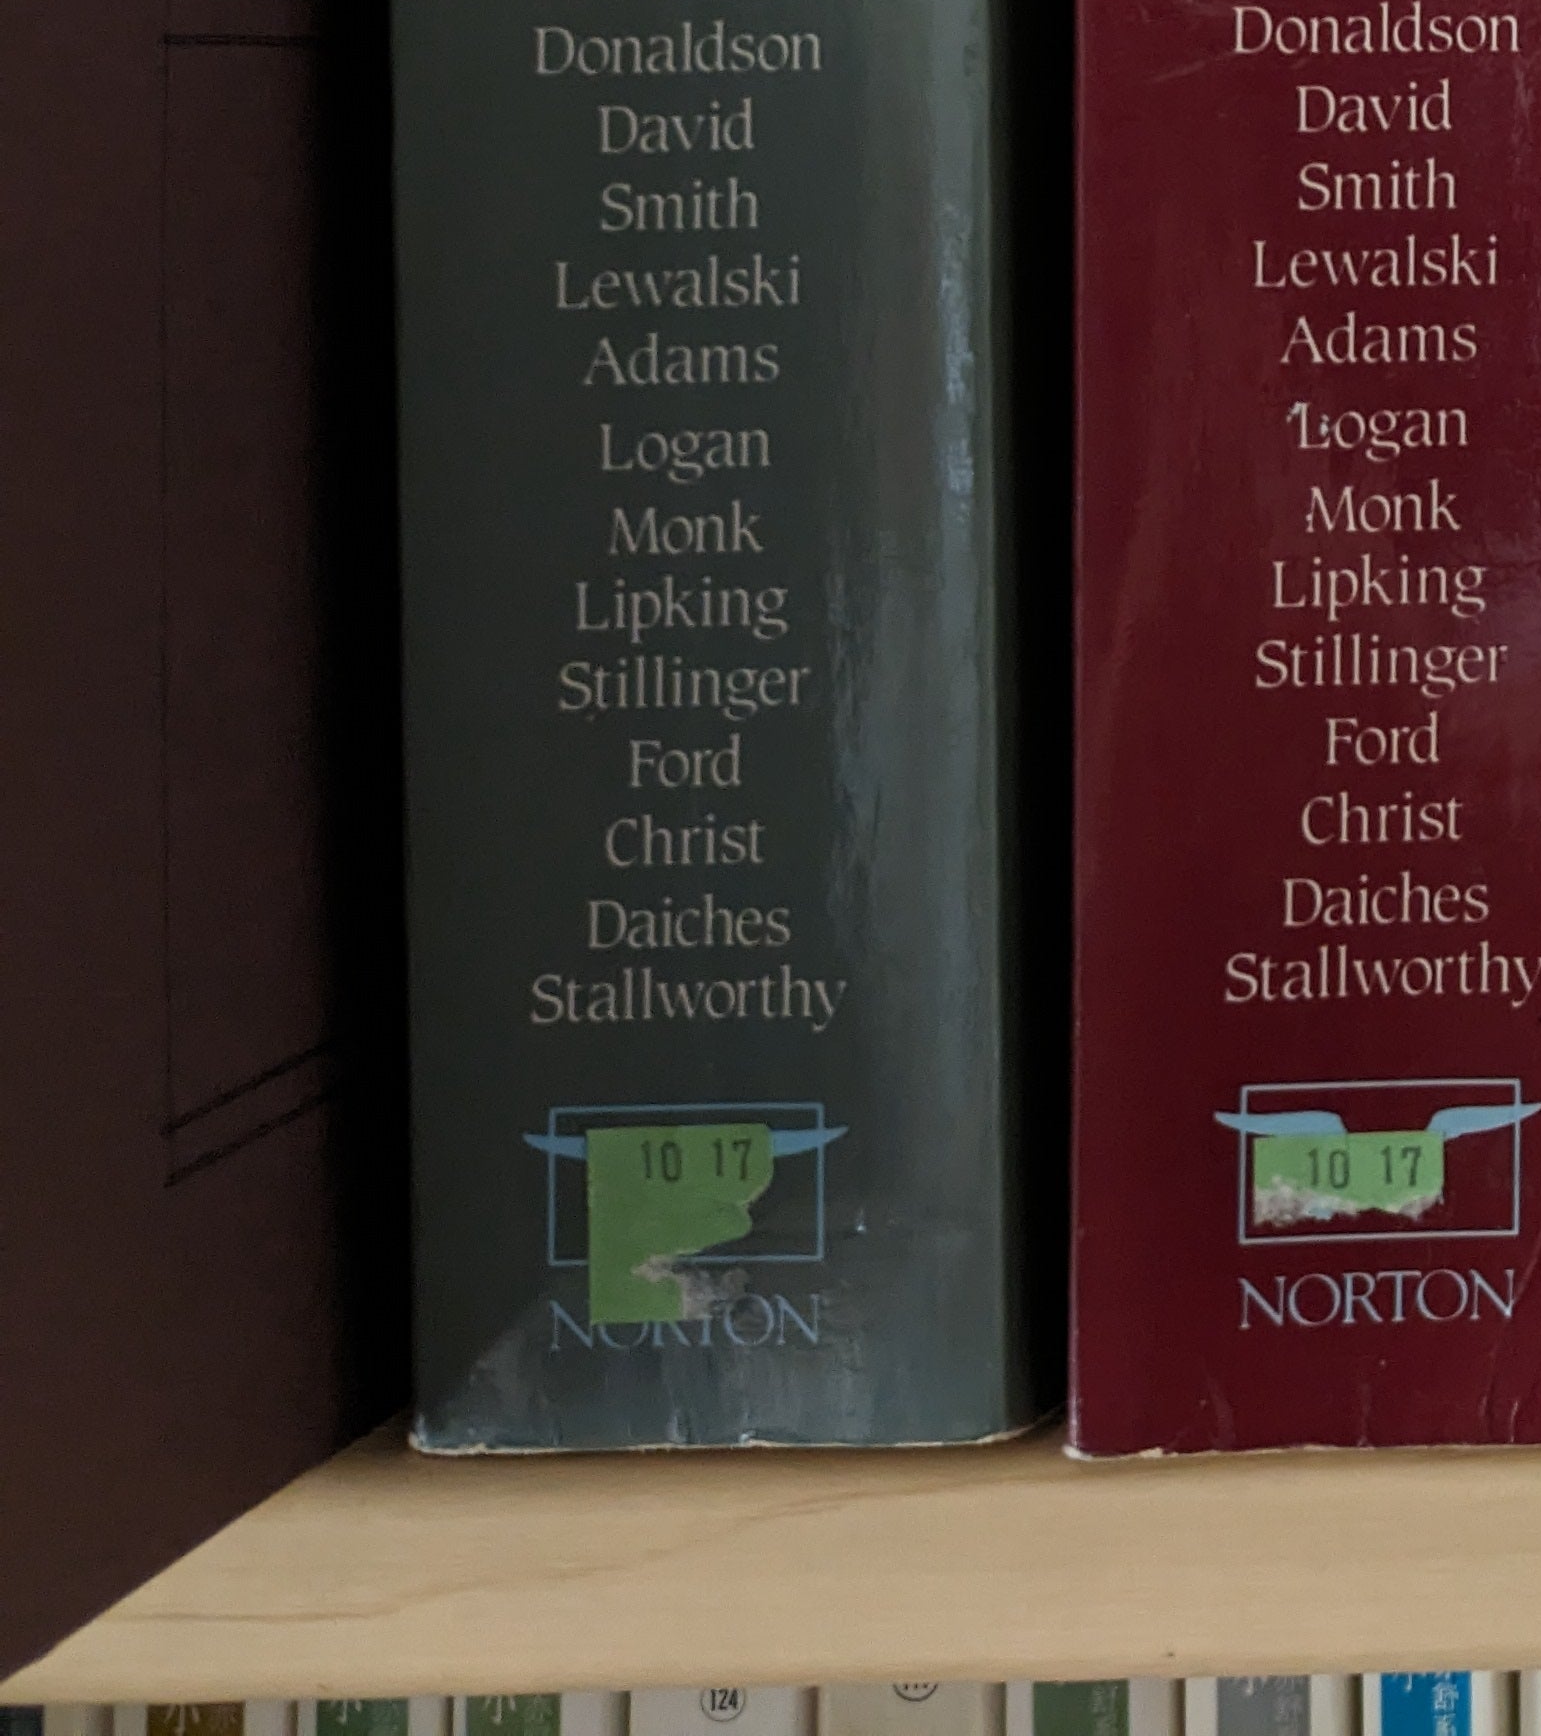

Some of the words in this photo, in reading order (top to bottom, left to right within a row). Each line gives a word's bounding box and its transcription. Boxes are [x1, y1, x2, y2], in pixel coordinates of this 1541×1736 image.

[534, 19, 822, 75] Donaldson
[1232, 1, 1520, 55] Donaldson
[599, 97, 755, 155] David
[1296, 79, 1452, 133] David
[600, 178, 760, 232] Smith
[1298, 158, 1457, 211] Smith
[556, 254, 801, 311] Lewalski
[1253, 234, 1500, 288] Lewalski
[582, 332, 780, 387] Adams
[1280, 311, 1478, 365] Adams
[600, 423, 771, 486] Logan
[1296, 401, 1469, 463] Logan
[608, 500, 765, 556] Monk
[1306, 479, 1462, 533] Monk
[576, 575, 790, 645] Lipking
[1272, 554, 1489, 621] Lipking
[559, 655, 812, 721] Stillinger
[1255, 633, 1508, 699] Stillinger
[629, 733, 742, 789] Ford
[1325, 711, 1440, 766] Ford
[605, 813, 766, 868] Christ
[1301, 791, 1464, 845] Christ
[587, 894, 791, 950] Daiches
[1282, 870, 1490, 928] Daiches
[531, 965, 847, 1033] Stallworthy
[641, 1140, 683, 1182] 10
[713, 1138, 753, 1182] 17
[1308, 1148, 1351, 1190] 10
[1381, 1145, 1423, 1188] 17
[1238, 1268, 1516, 1330] NORTON
[709, 1689, 741, 1712] 124
